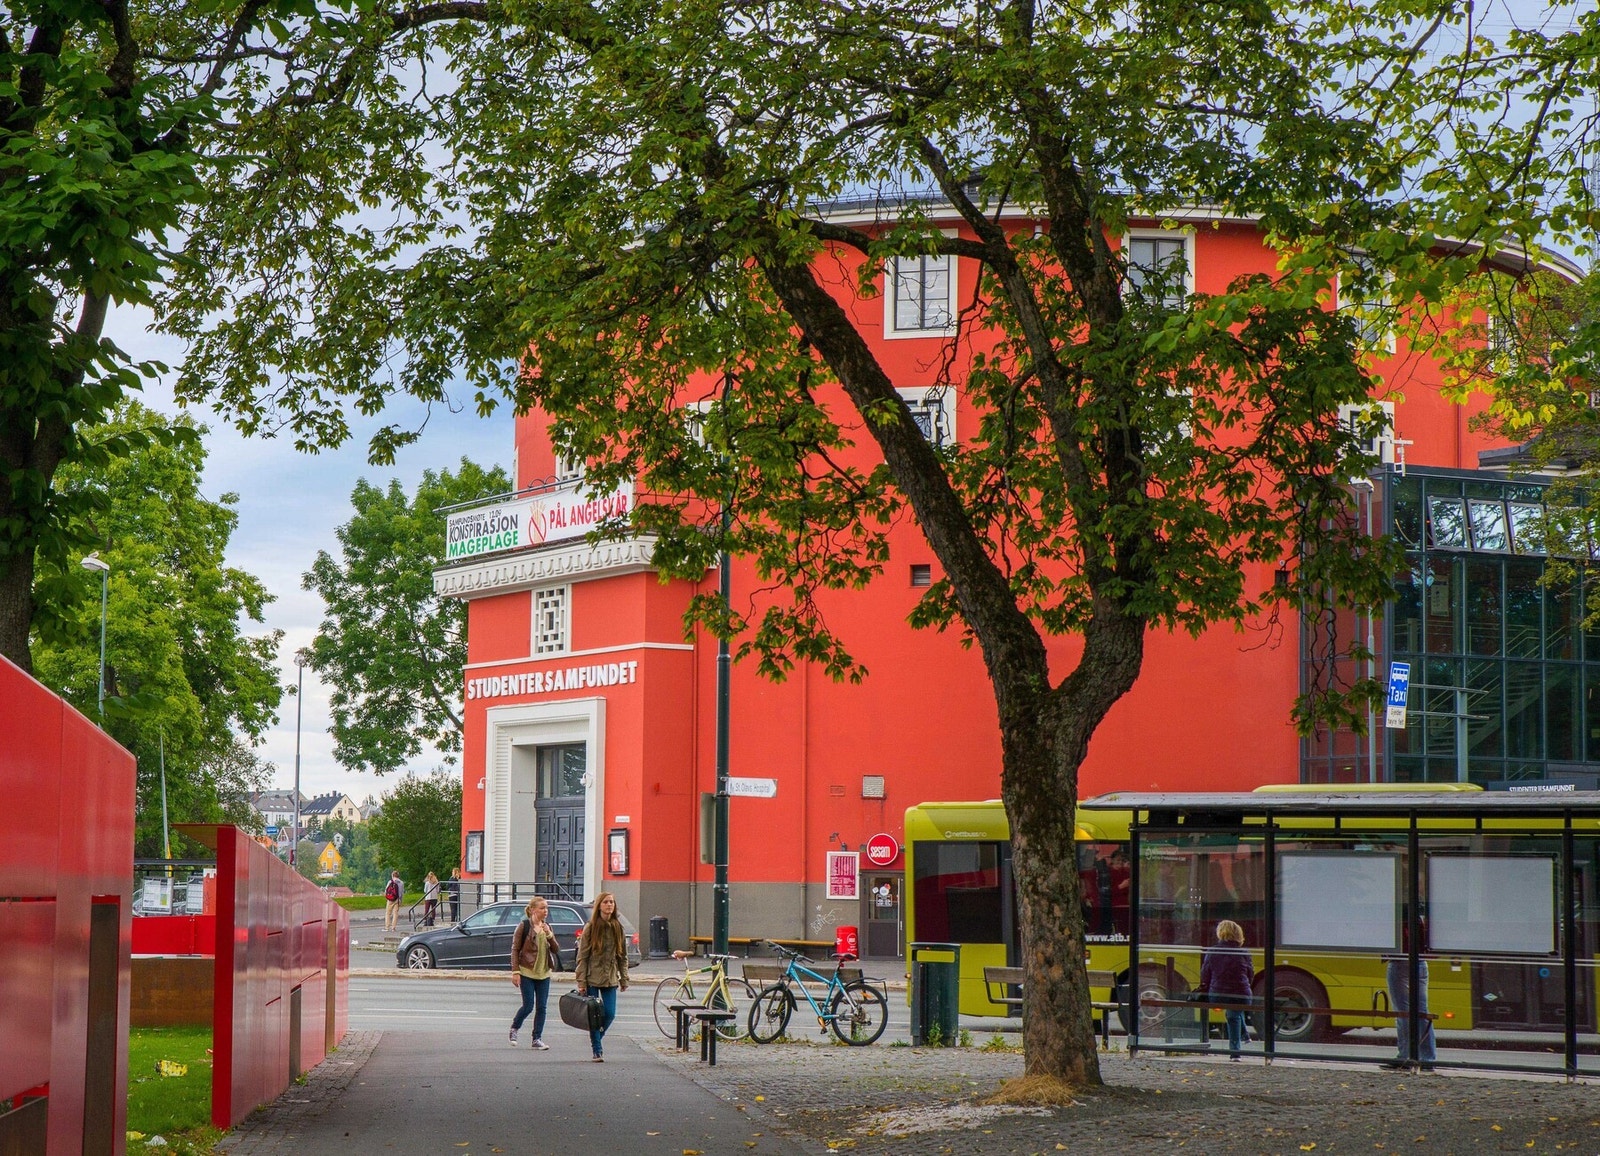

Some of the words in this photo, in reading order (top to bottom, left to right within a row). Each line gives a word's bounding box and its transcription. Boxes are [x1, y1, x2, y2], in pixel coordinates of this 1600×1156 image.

[549, 502, 567, 530] PÅL
[570, 489, 628, 527] ANGELSKÅR
[449, 514, 518, 543] KONSPIRASJON
[448, 530, 519, 558] MAGEPLAGE
[467, 660, 638, 700] STUDENTERSAMFUNDET
[1390, 686, 1407, 702] Taxi
[1542, 784, 1575, 792] SAMFUNDET
[870, 845, 891, 858] sesam
